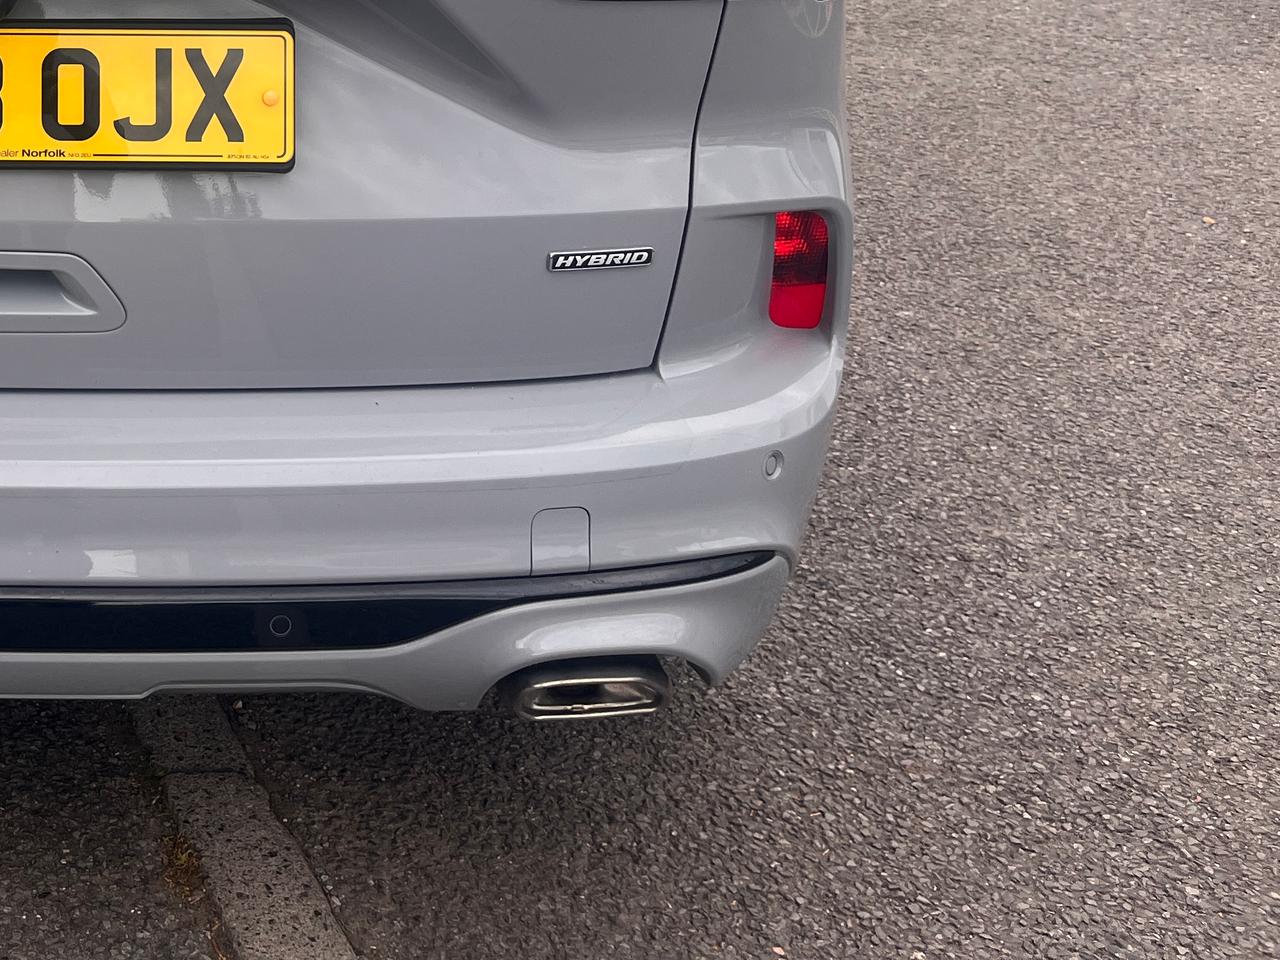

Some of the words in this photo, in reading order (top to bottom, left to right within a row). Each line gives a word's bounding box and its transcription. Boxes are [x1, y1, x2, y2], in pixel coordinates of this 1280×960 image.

[41, 47, 245, 143] OJX
[21, 149, 66, 158] Norfolk
[554, 251, 649, 268] HYBRID
